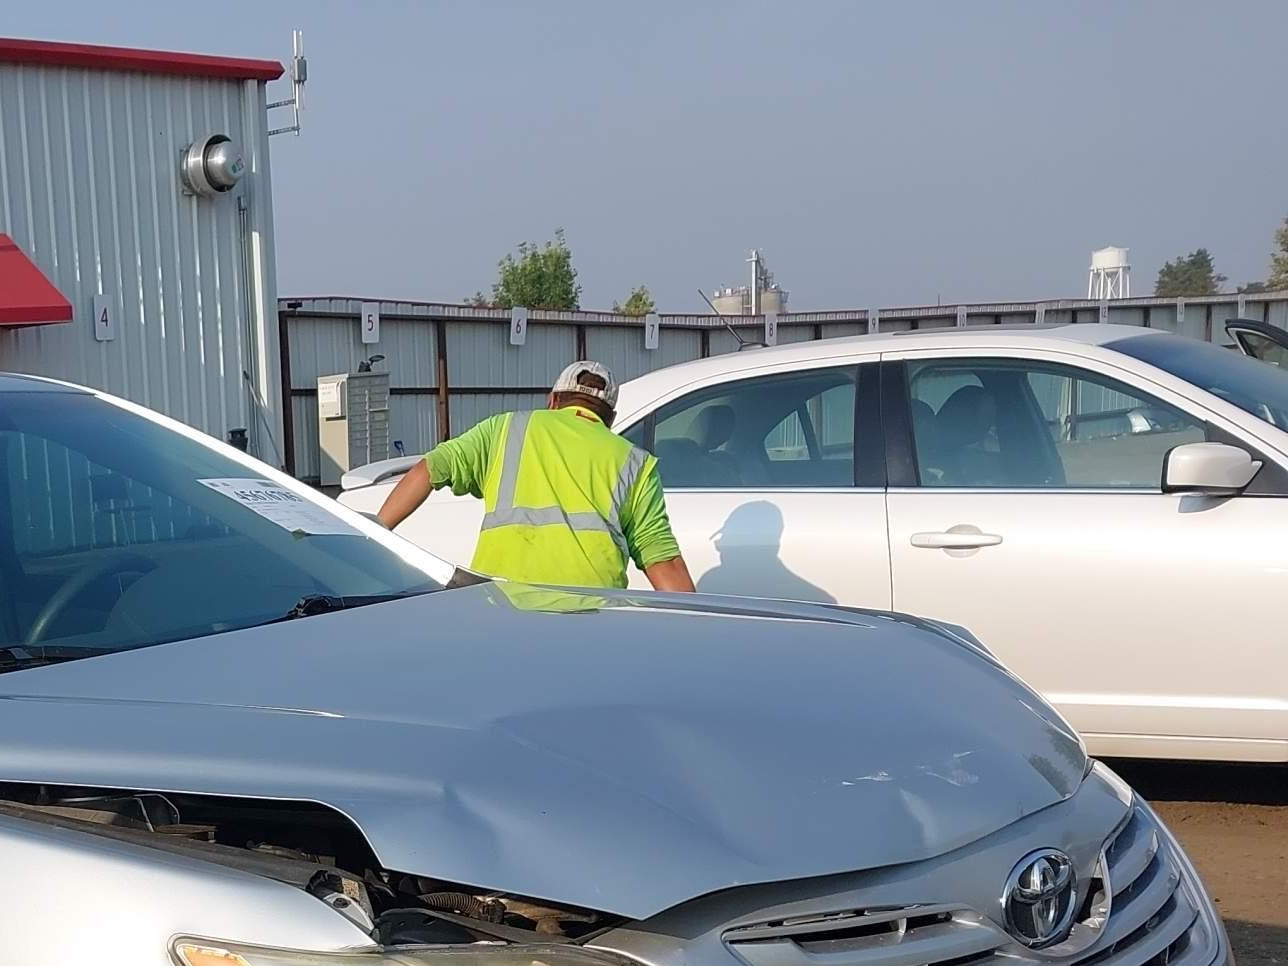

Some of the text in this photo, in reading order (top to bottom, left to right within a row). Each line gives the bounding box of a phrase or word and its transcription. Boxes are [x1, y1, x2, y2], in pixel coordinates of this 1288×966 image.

[100, 307, 109, 328] 4
[367, 314, 374, 332] 5
[515, 318, 522, 334] 6
[649, 324, 655, 340] 7
[768, 322, 774, 337] 8
